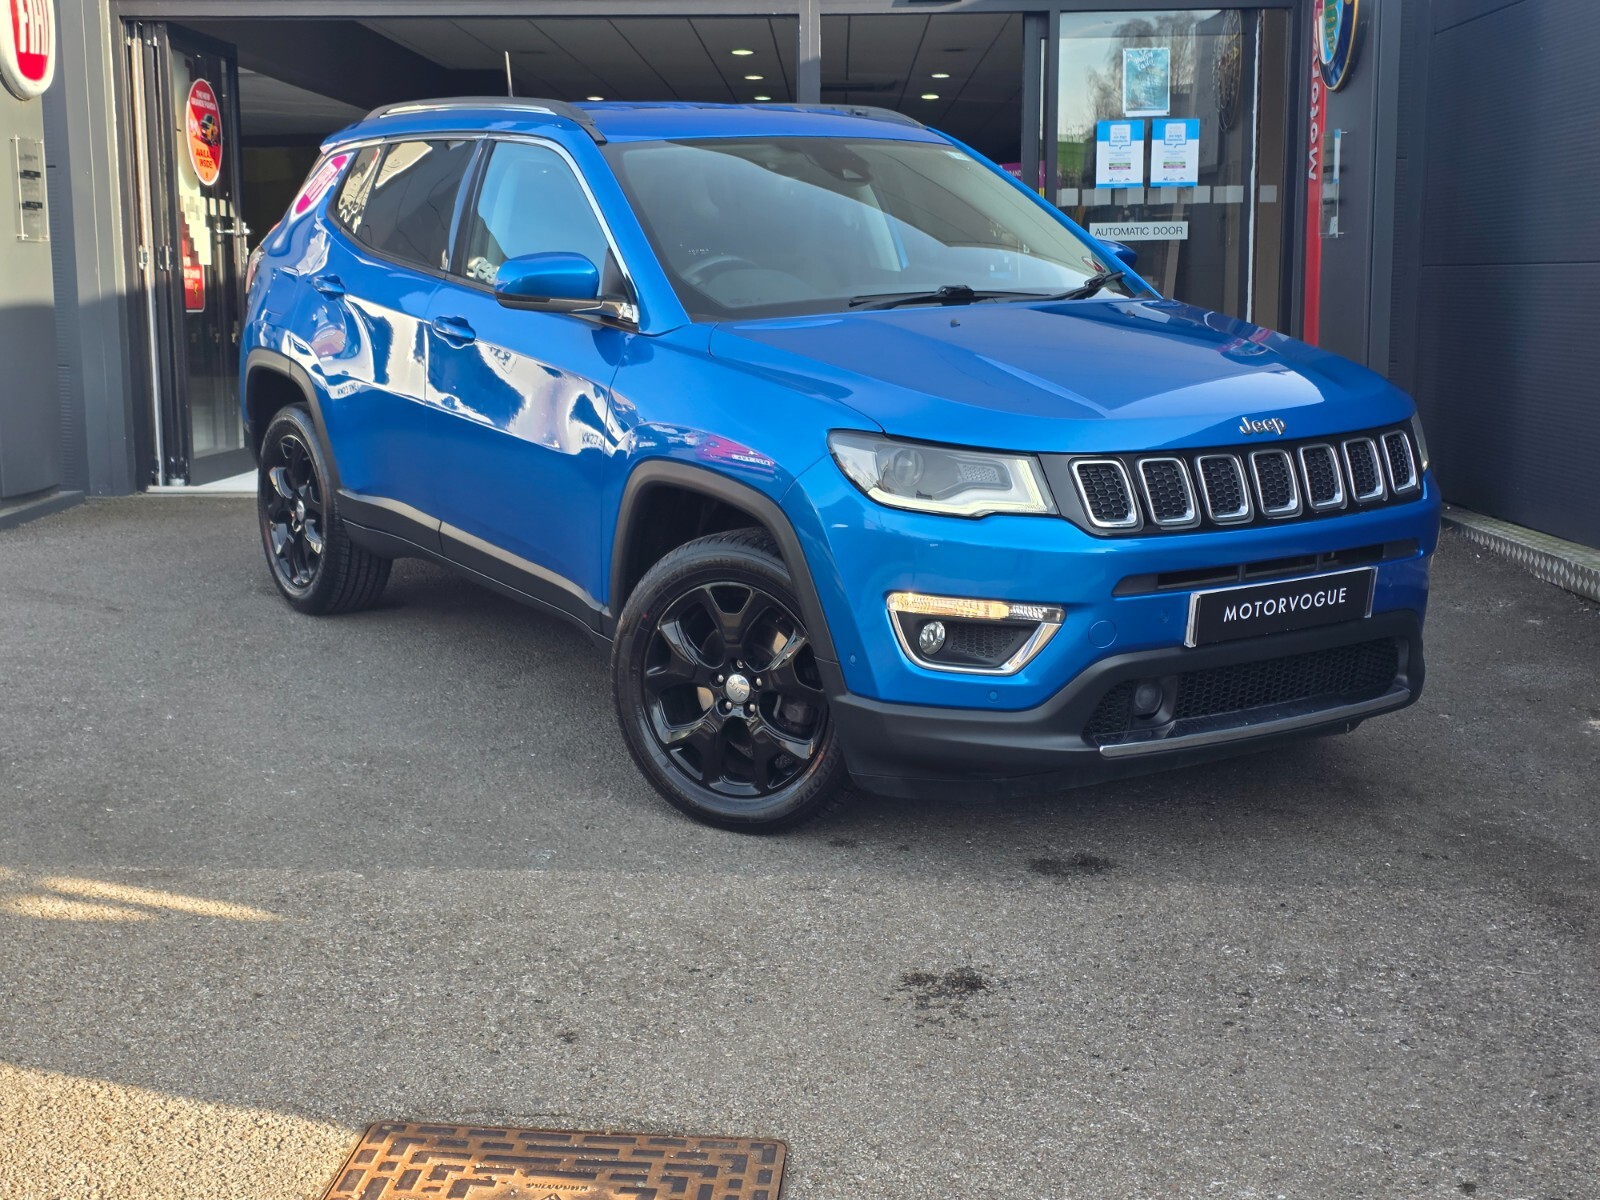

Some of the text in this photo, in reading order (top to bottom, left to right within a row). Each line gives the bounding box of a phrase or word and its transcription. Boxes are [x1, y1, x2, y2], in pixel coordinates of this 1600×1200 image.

[1095, 226, 1183, 236] AUTOMATIC DOOR
[1239, 416, 1286, 435] Jeep
[1223, 587, 1347, 622] MOTORVOGUE
